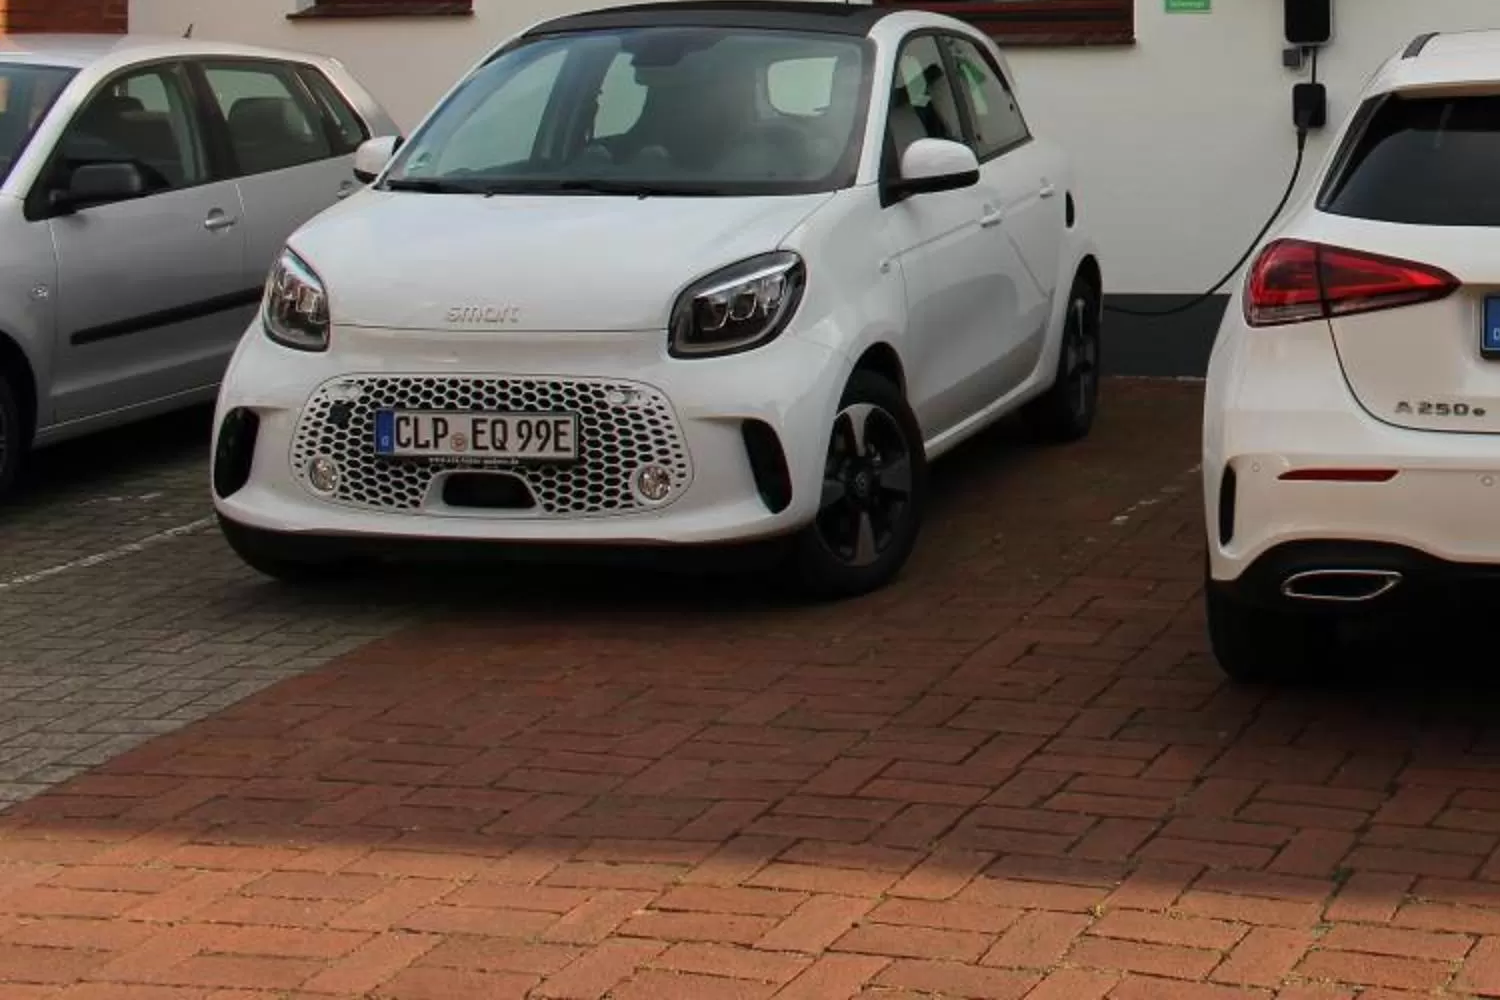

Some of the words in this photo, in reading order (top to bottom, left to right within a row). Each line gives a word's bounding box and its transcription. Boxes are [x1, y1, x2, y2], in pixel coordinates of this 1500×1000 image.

[447, 303, 520, 323] smart
[396, 416, 449, 449] CLP
[471, 418, 508, 450] EQ
[516, 419, 571, 451] 99E
